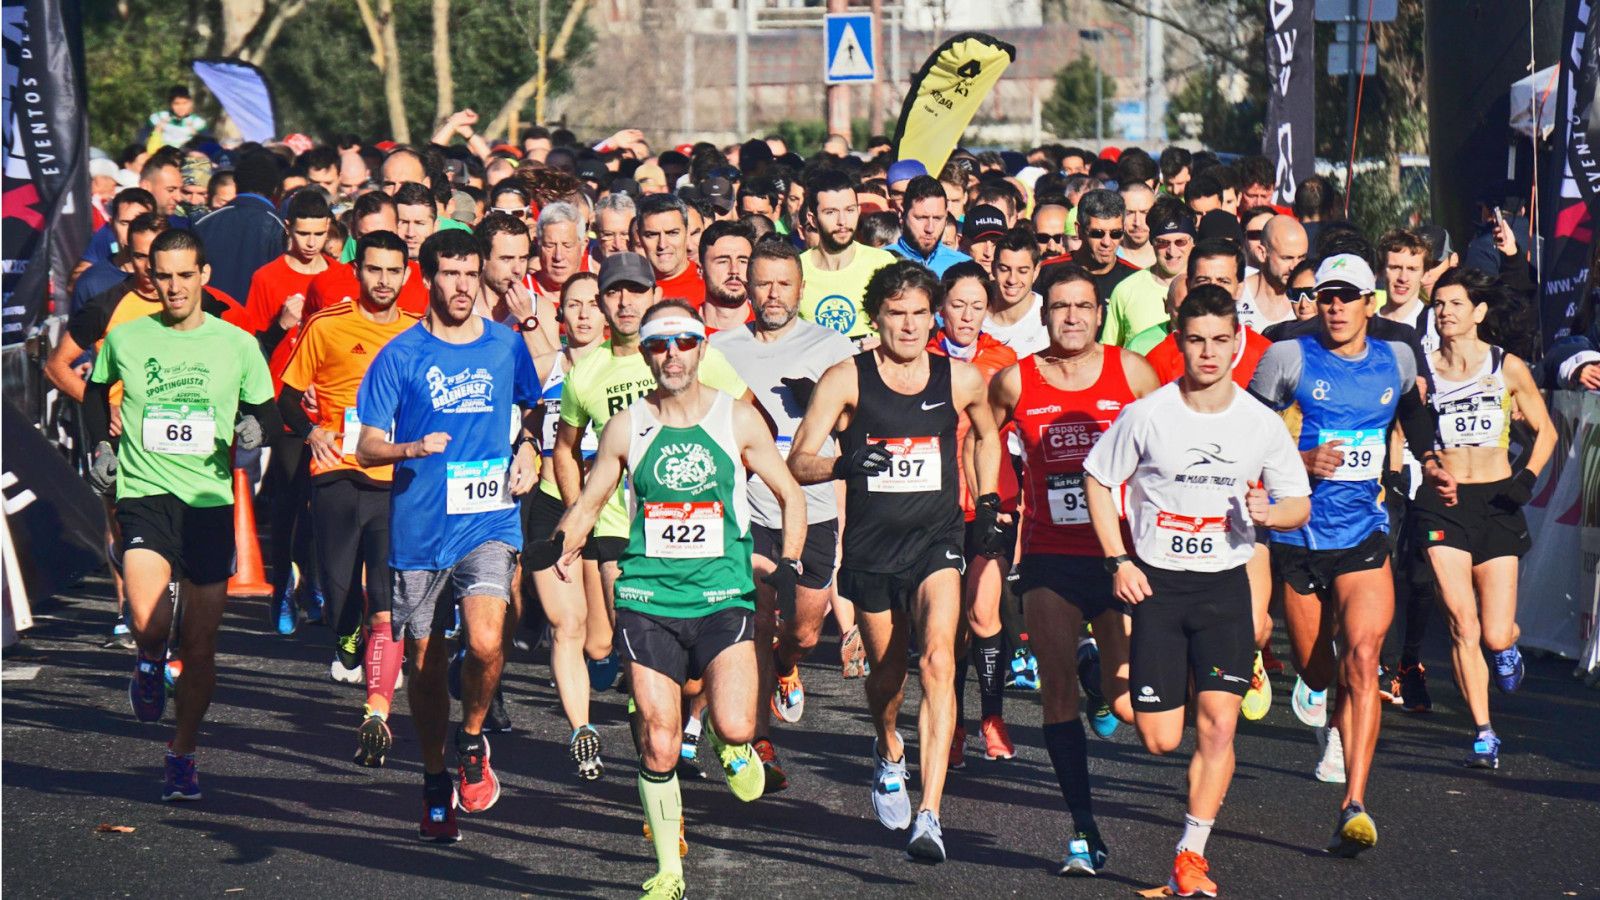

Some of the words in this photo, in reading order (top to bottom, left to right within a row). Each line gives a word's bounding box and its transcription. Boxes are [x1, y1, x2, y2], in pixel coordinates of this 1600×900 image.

[23, 77, 60, 175] EVENTOS
[146, 377, 204, 398] SPORTINGUISTA
[606, 382, 633, 395] KEEP
[166, 424, 193, 441] 68
[1048, 424, 1086, 436] espaço
[1455, 416, 1491, 432] 876
[1049, 431, 1104, 448] casa
[1340, 450, 1372, 468] 39
[888, 459, 925, 478] 197
[464, 480, 499, 500] 109
[661, 525, 706, 543] 422
[1171, 535, 1213, 554] 866
[367, 632, 390, 689] kalenji
